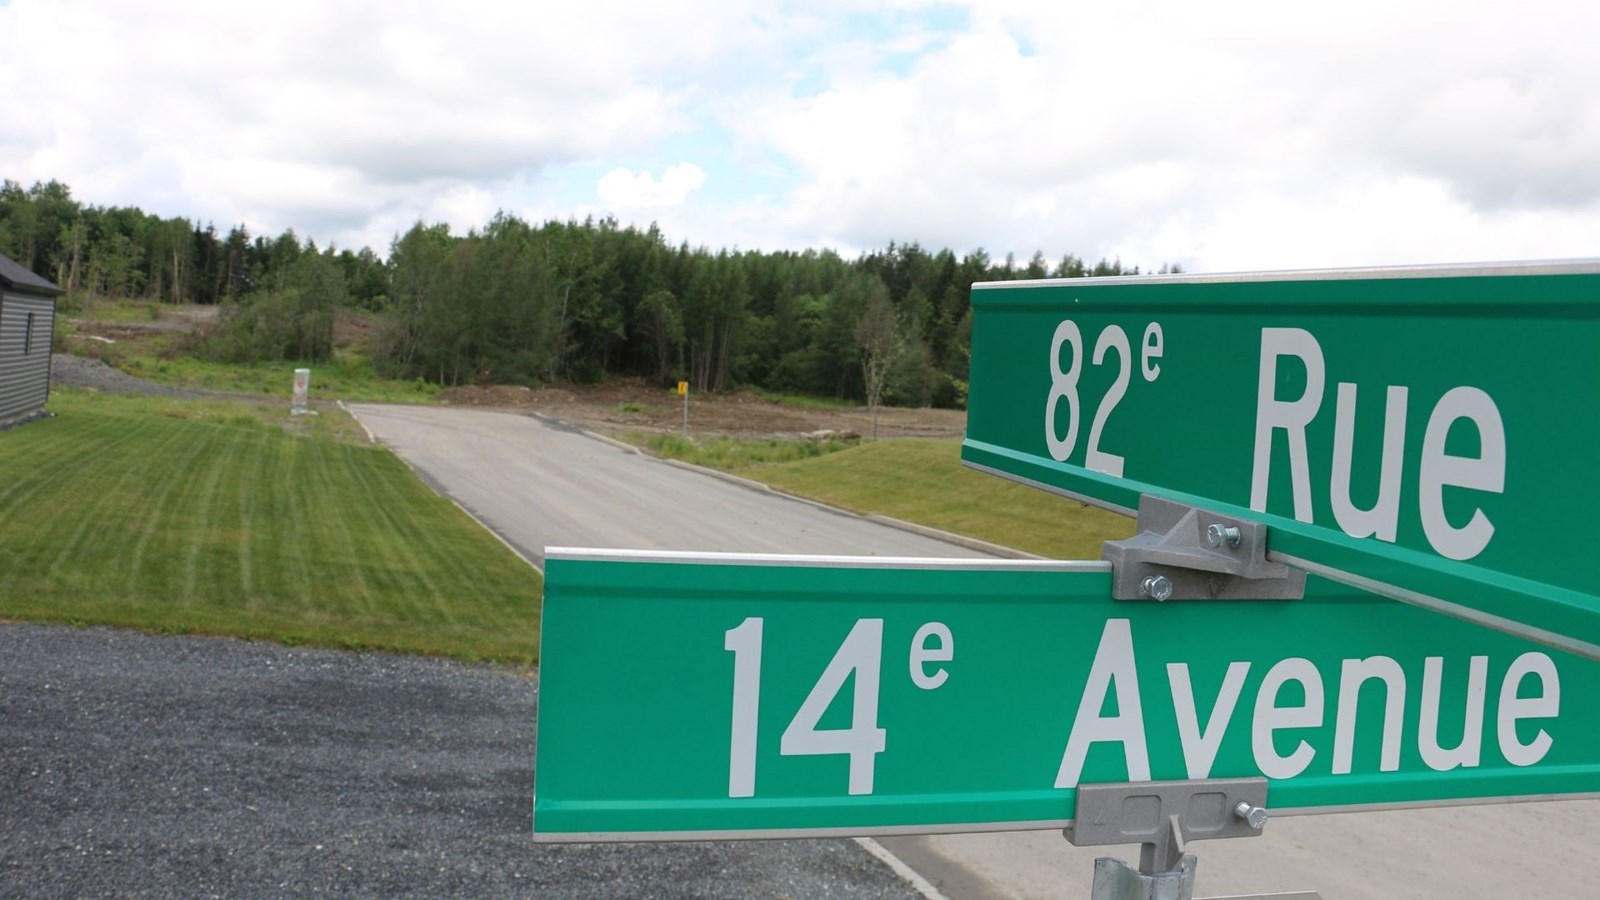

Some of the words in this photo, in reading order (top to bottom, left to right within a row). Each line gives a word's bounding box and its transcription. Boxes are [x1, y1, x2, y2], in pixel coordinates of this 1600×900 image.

[1045, 319, 1164, 479] 82e
[1249, 326, 1506, 561] Rue
[724, 617, 954, 798] 14e
[1053, 617, 1561, 790] Avenue
